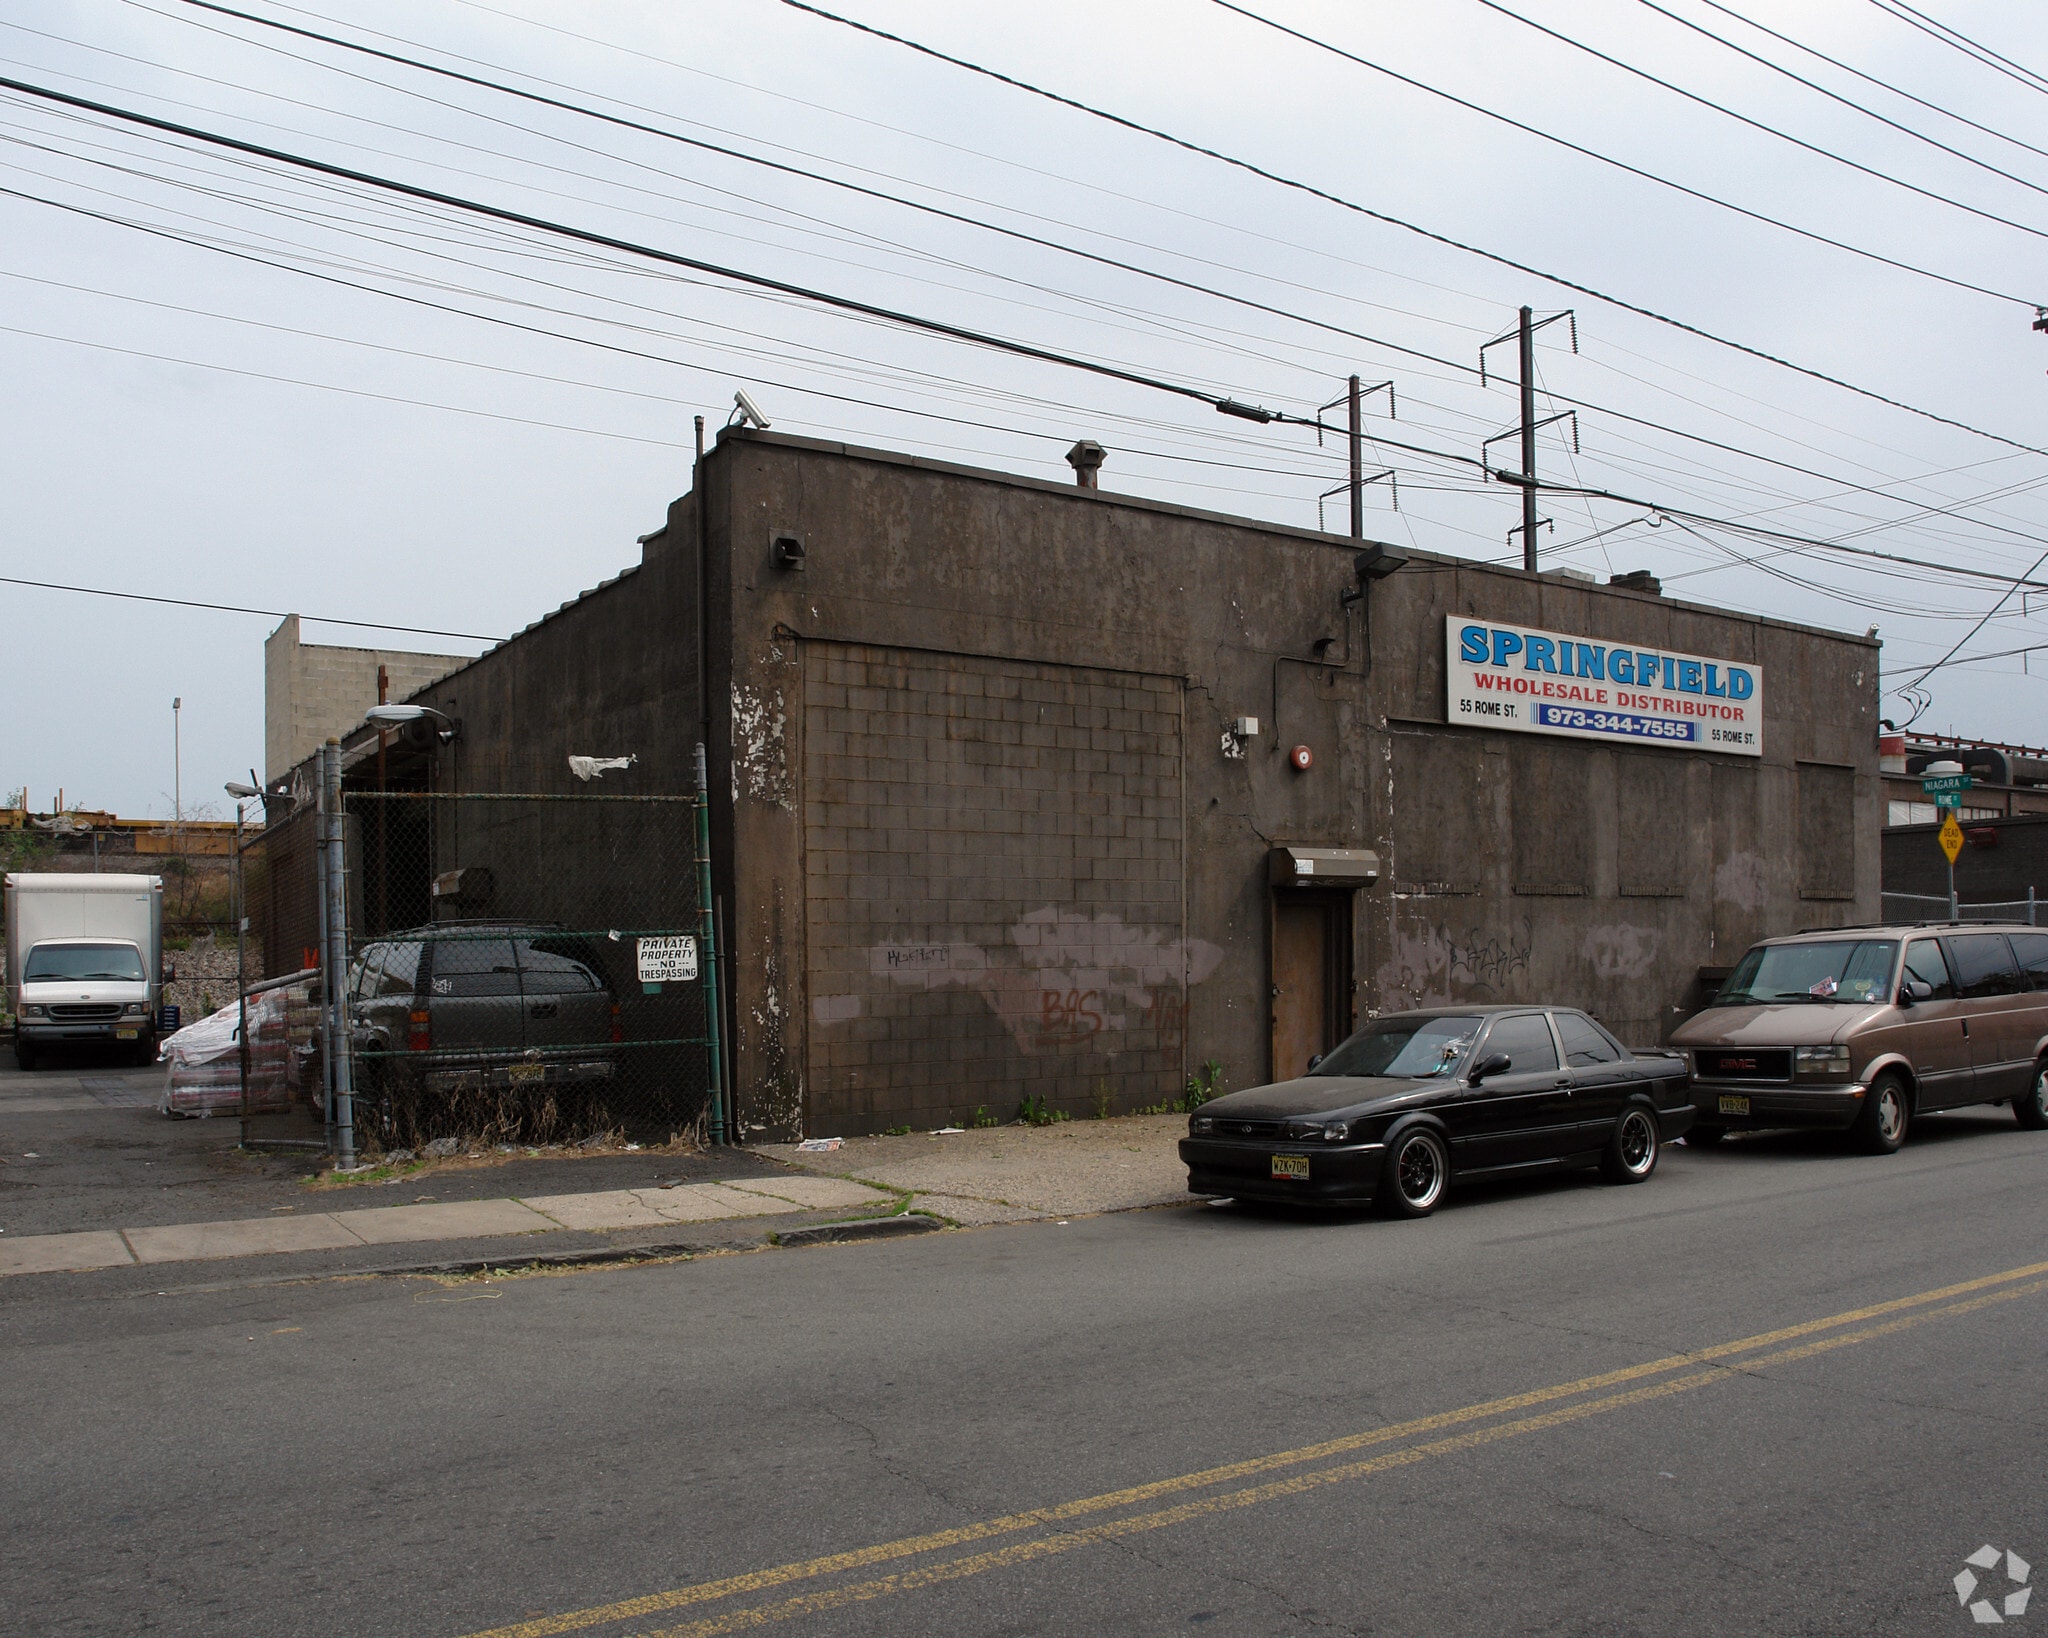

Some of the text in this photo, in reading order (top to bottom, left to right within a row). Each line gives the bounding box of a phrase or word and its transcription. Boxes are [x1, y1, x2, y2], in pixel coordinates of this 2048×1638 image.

[1459, 625, 1754, 701] SPRINGFIELD
[1473, 672, 1744, 721] WHOLESALE DISTRIBUTOR
[1460, 699, 1518, 718] 55 ROME ST.
[1547, 708, 1688, 739] 973-344-7555
[1711, 729, 1755, 745] 55 ROME ST.
[1925, 778, 1960, 790] NIAGARA
[1938, 795, 1952, 805] ROME
[1944, 828, 1958, 837] DEAD
[1946, 839, 1957, 849] END
[643, 939, 691, 949] PRIVATE
[641, 950, 694, 960] PROPERTY
[660, 960, 676, 968] NO
[640, 968, 697, 979] TRESPASSING
[1720, 1058, 1757, 1069] GMC
